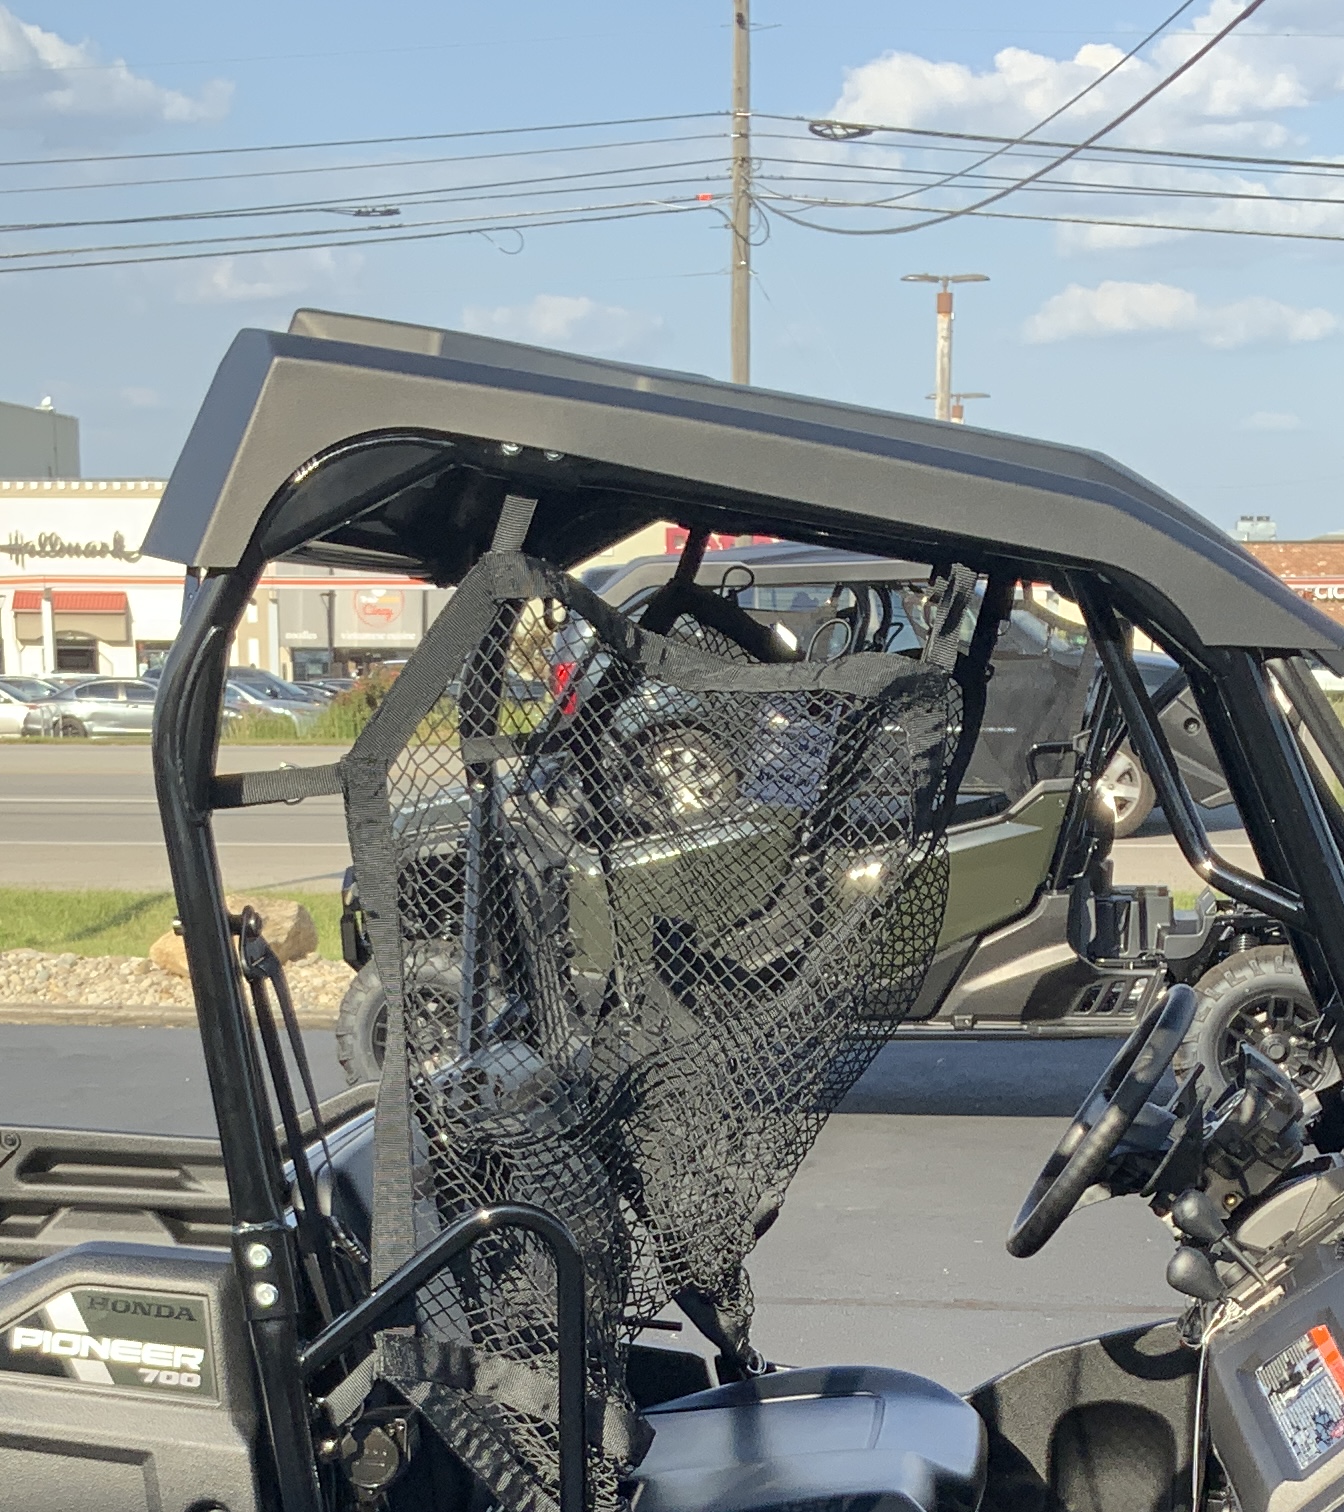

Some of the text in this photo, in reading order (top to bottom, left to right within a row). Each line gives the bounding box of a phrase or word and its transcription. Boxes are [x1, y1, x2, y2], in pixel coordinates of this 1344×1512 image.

[87, 1295, 198, 1322] HONDA
[12, 1327, 206, 1371] PIONEER
[138, 1367, 202, 1388] 700
